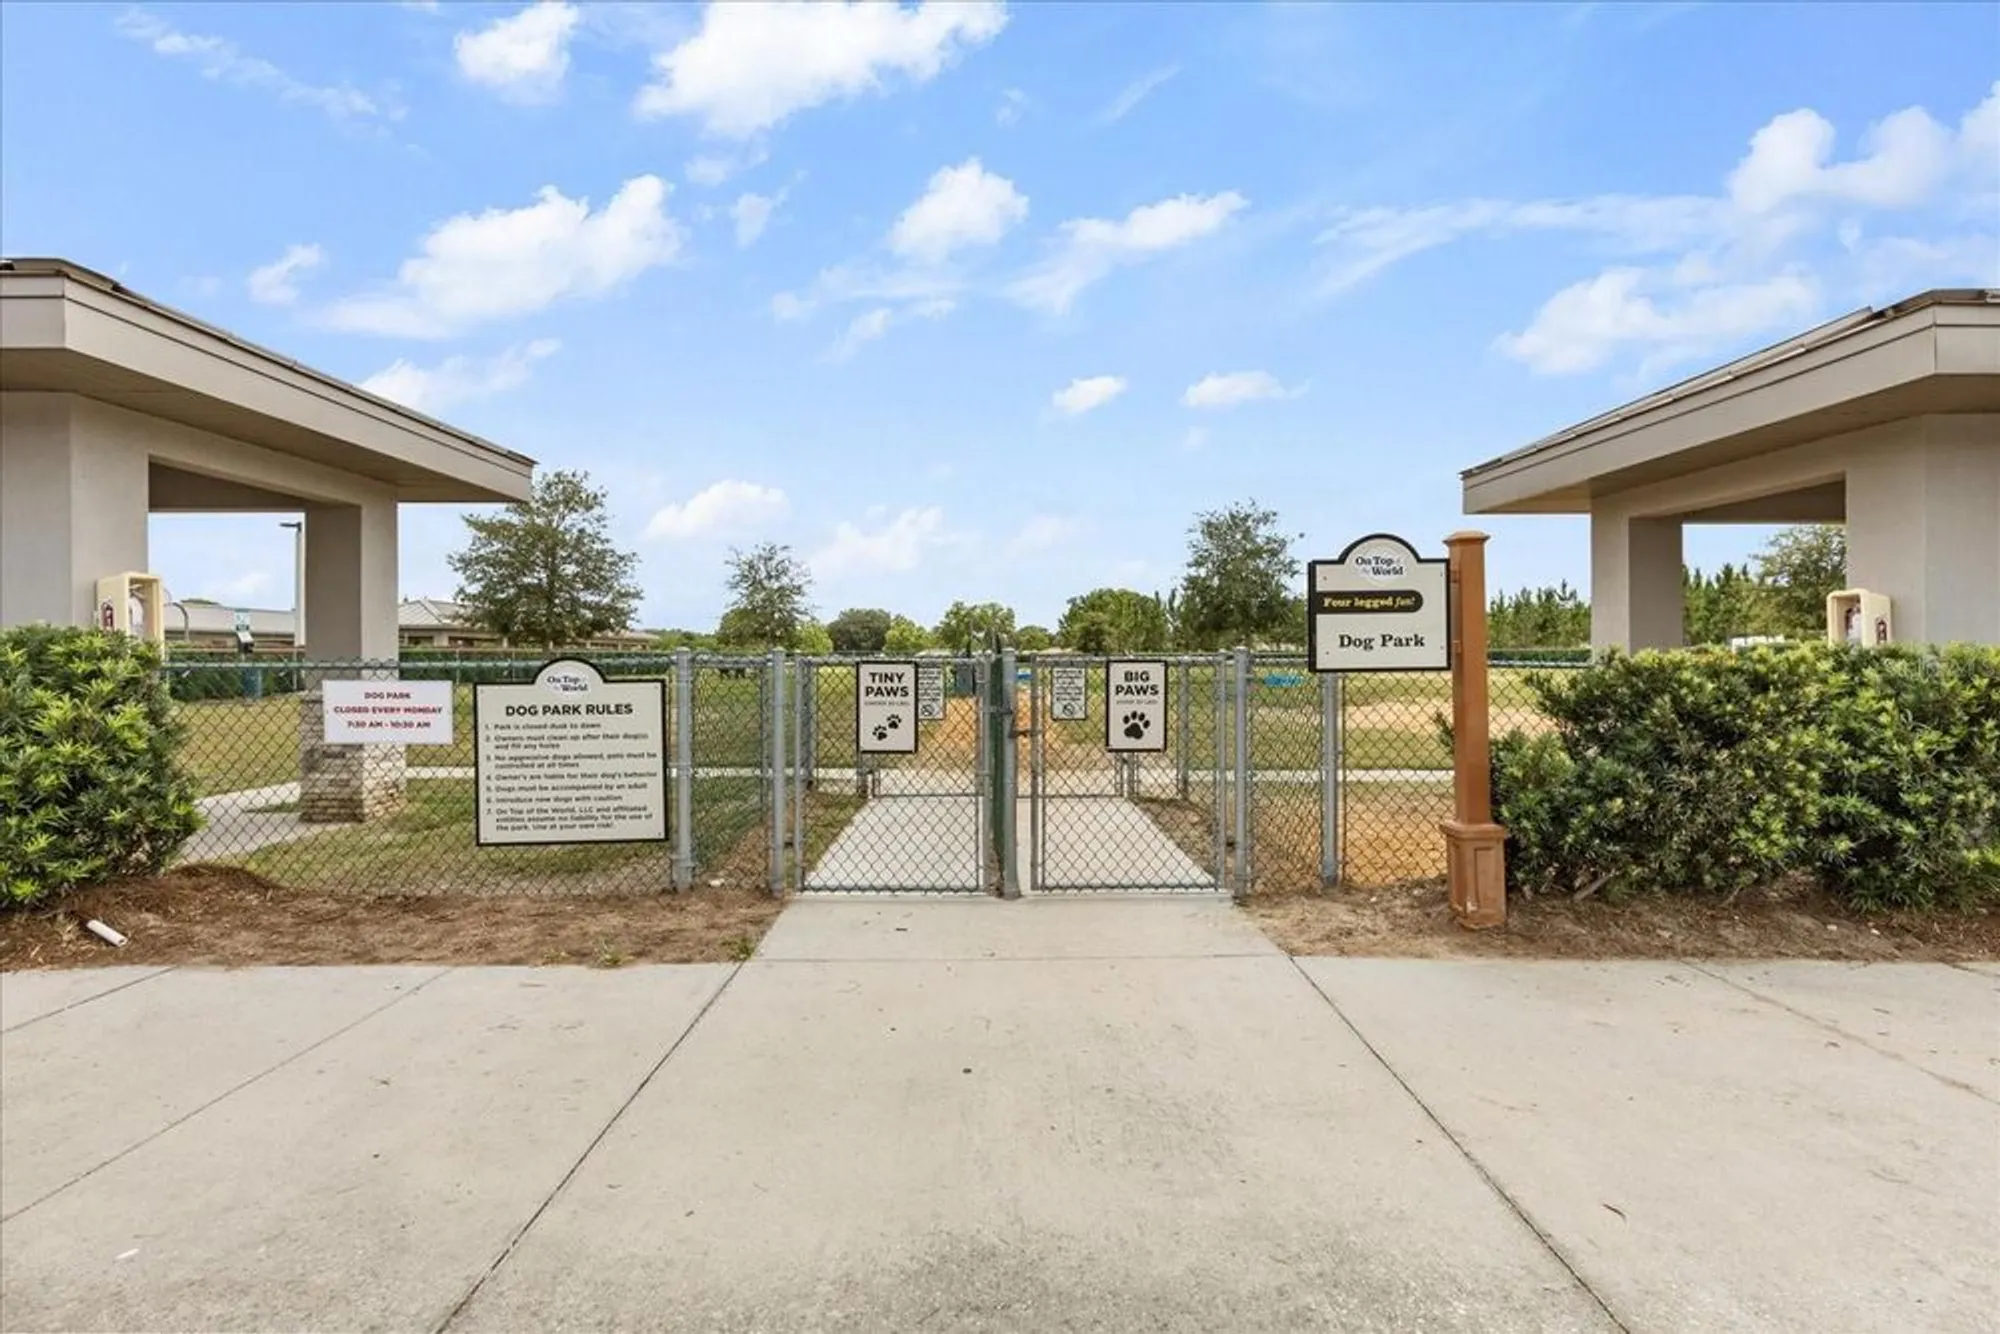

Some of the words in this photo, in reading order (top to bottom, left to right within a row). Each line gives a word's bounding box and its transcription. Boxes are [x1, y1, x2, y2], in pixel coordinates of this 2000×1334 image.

[1356, 556, 1372, 566] On
[1373, 556, 1395, 567] Top
[1372, 566, 1404, 576] World
[1323, 598, 1352, 608] Four
[1354, 597, 1393, 609] legged
[1395, 596, 1416, 609] fun!
[1339, 634, 1375, 651] Dog
[1380, 634, 1425, 647] Park
[561, 675, 580, 684] Top
[869, 672, 905, 683] TINY
[1124, 670, 1150, 683] BIG
[561, 684, 589, 692] World
[865, 686, 909, 698] PAWS
[1115, 684, 1159, 697] PAWS
[364, 692, 385, 700] DOG
[334, 706, 369, 714] CLOSED
[372, 706, 401, 714] EVERY
[404, 706, 443, 714] MONDAY
[506, 705, 538, 717] DOG
[542, 704, 581, 716] PARK
[586, 703, 633, 715] RULES
[390, 721, 415, 729] 10:30
[494, 723, 511, 731] Park
